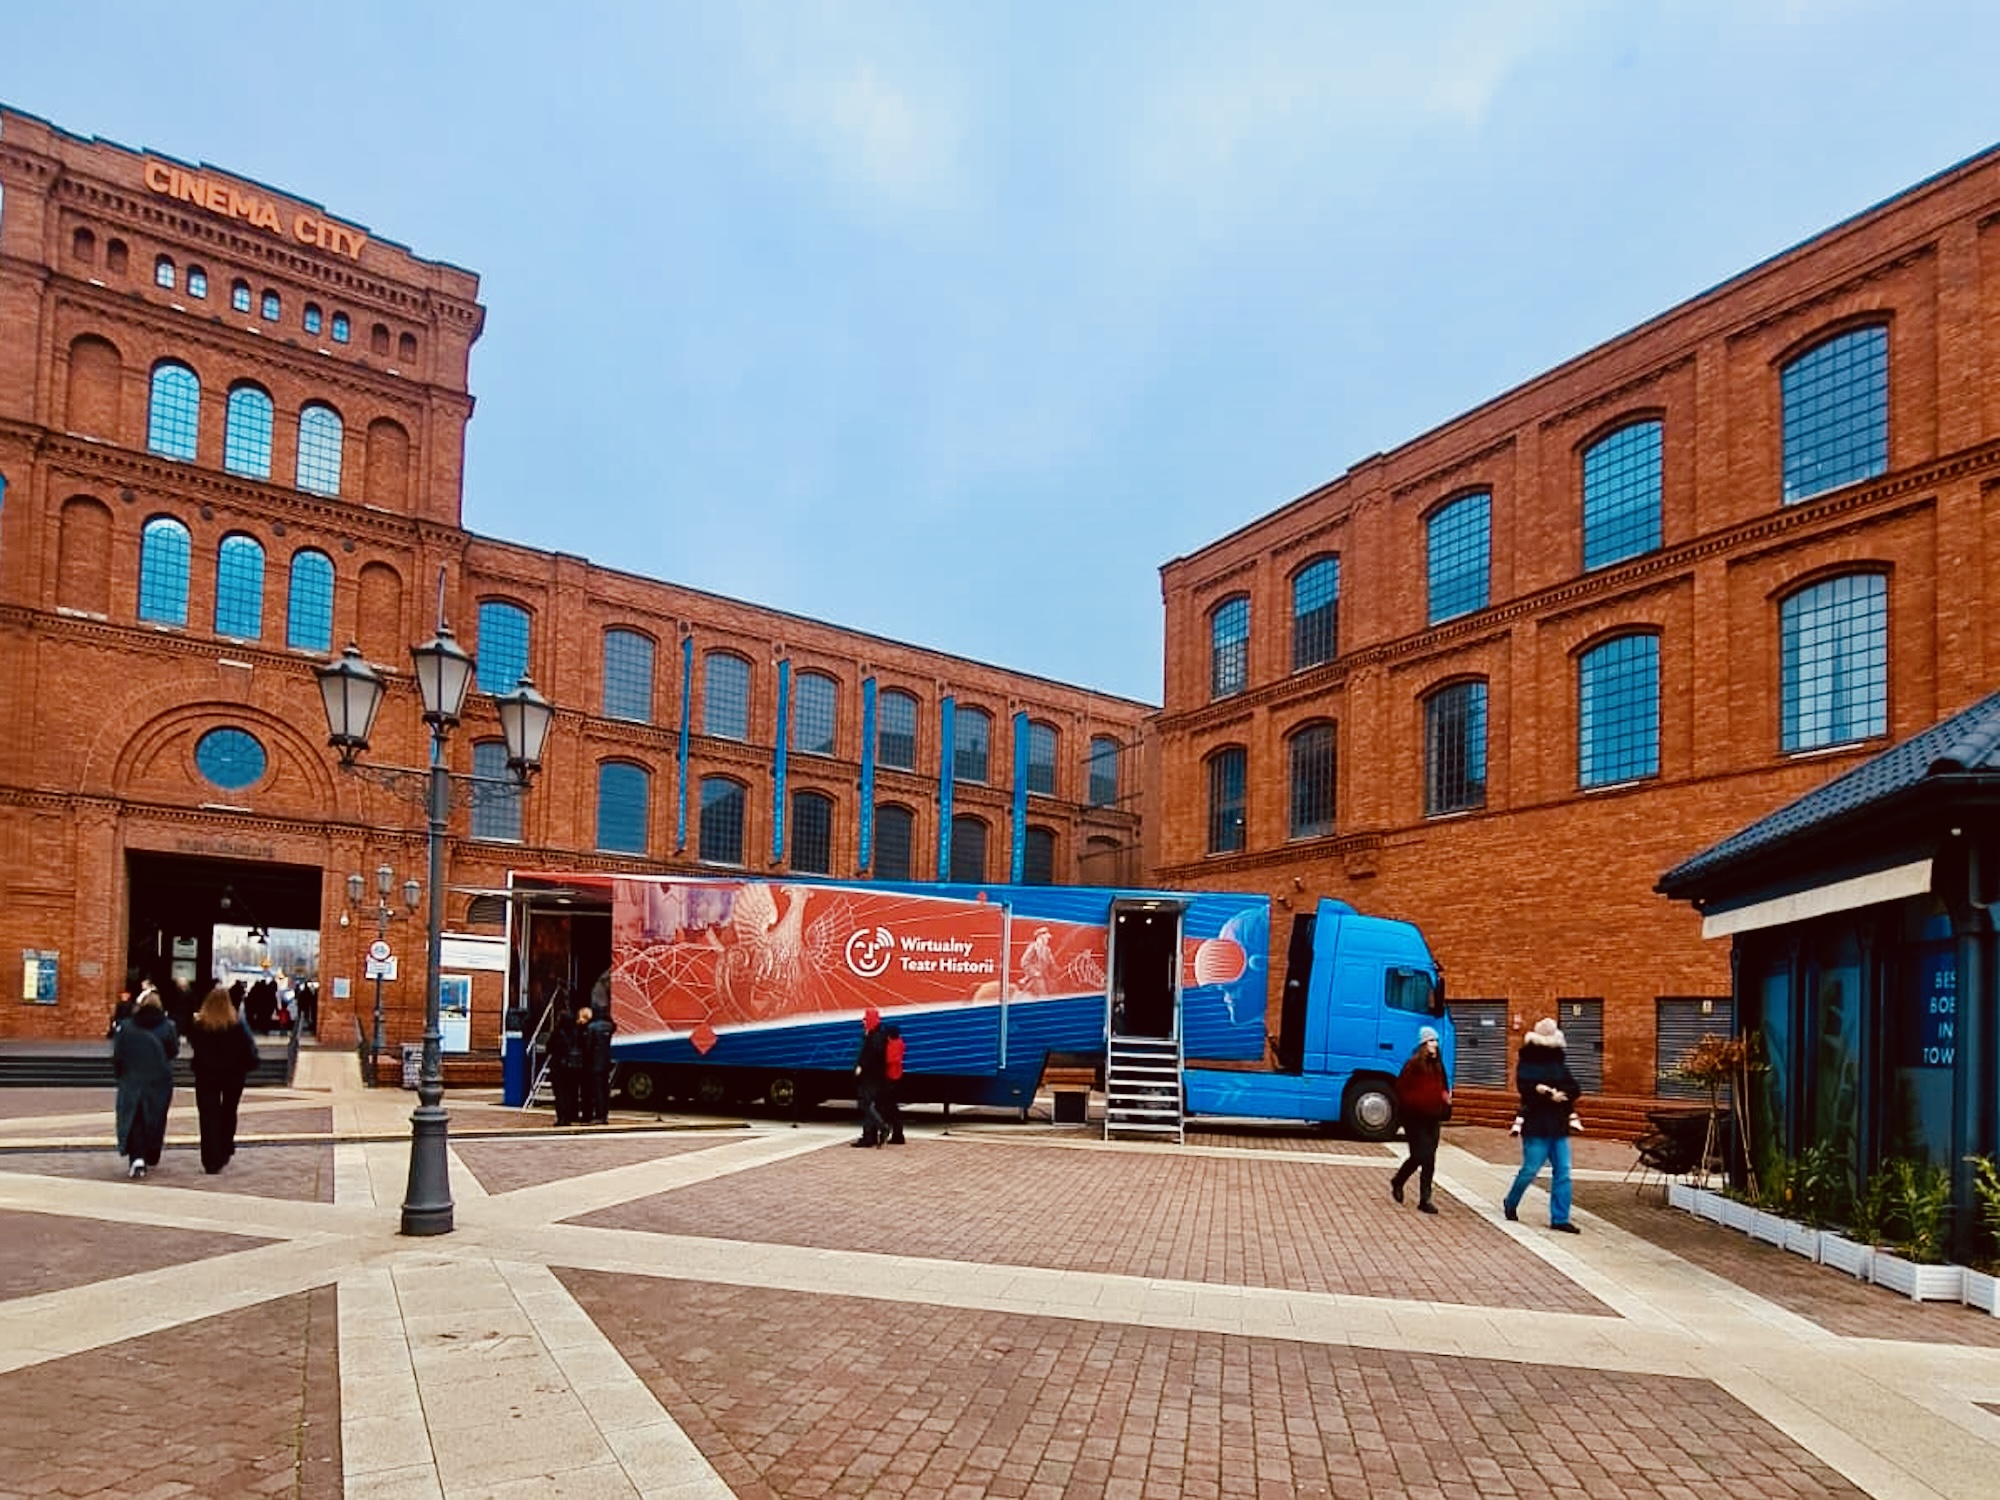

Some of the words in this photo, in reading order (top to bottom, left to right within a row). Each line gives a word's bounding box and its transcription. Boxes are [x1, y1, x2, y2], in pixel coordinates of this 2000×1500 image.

[144, 160, 283, 234] CINEMA
[294, 213, 368, 260] CITY
[900, 936, 973, 957] Wirtualny
[900, 957, 937, 972] Teatr
[939, 958, 995, 973] Historii
[1938, 1021, 1954, 1039] IN
